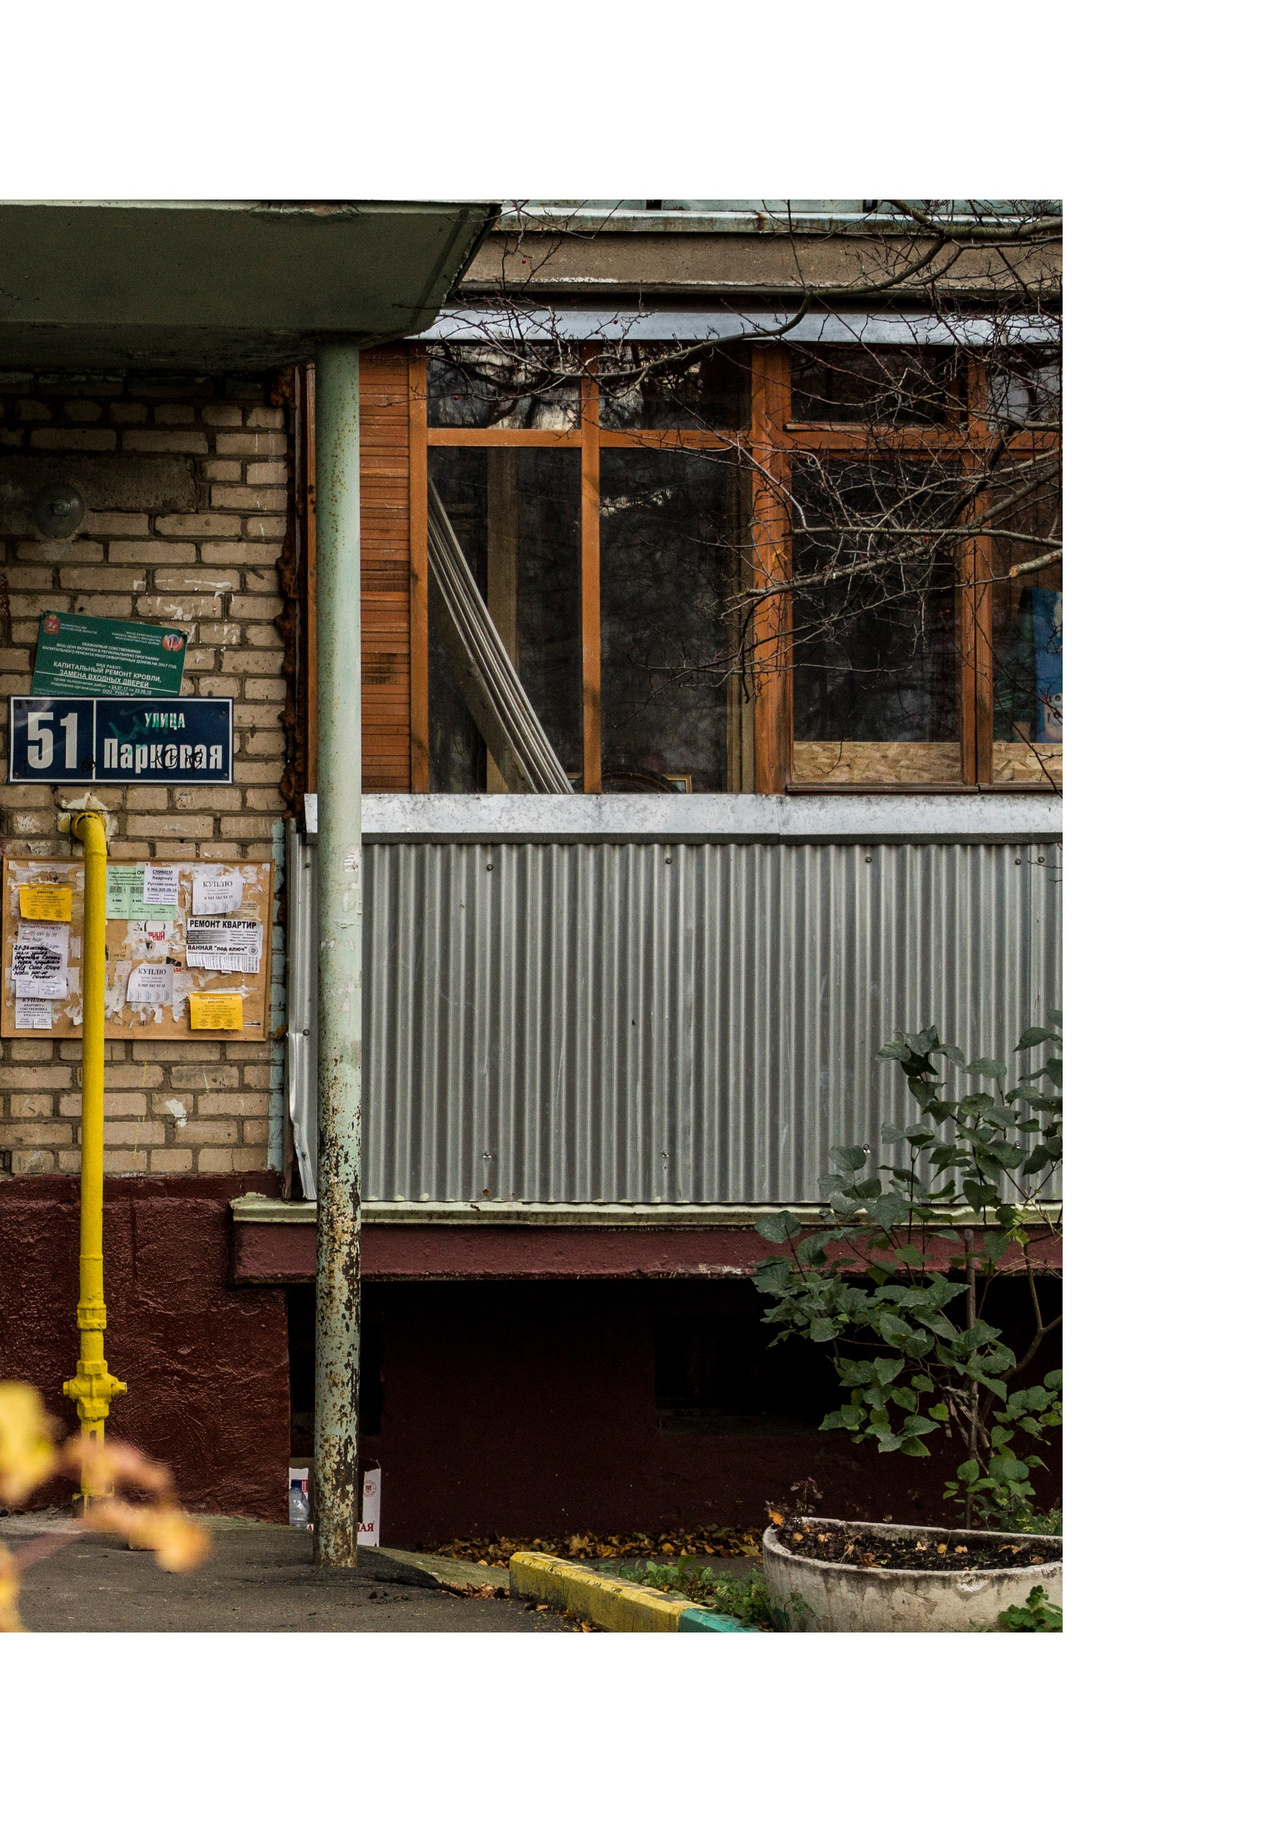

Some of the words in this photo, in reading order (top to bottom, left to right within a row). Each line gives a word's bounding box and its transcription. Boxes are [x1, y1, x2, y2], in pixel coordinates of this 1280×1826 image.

[53, 661, 104, 674] КАПИТАЛЬНЫЙ
[105, 668, 132, 678] РЕМОНТ
[133, 673, 162, 683] КРОВЛИ,
[59, 669, 87, 679] ЗАМЕНА
[88, 674, 121, 684] ВХОДНЫХ
[122, 678, 149, 688] ДВЕРЕЙ
[27, 711, 78, 769] 51
[104, 738, 223, 774] Парковая
[202, 880, 233, 888] КУПЛЮ
[189, 920, 221, 928] РЕМОНТ
[222, 920, 257, 929] КВАРТИР
[137, 968, 167, 976] КУПЛЮ
